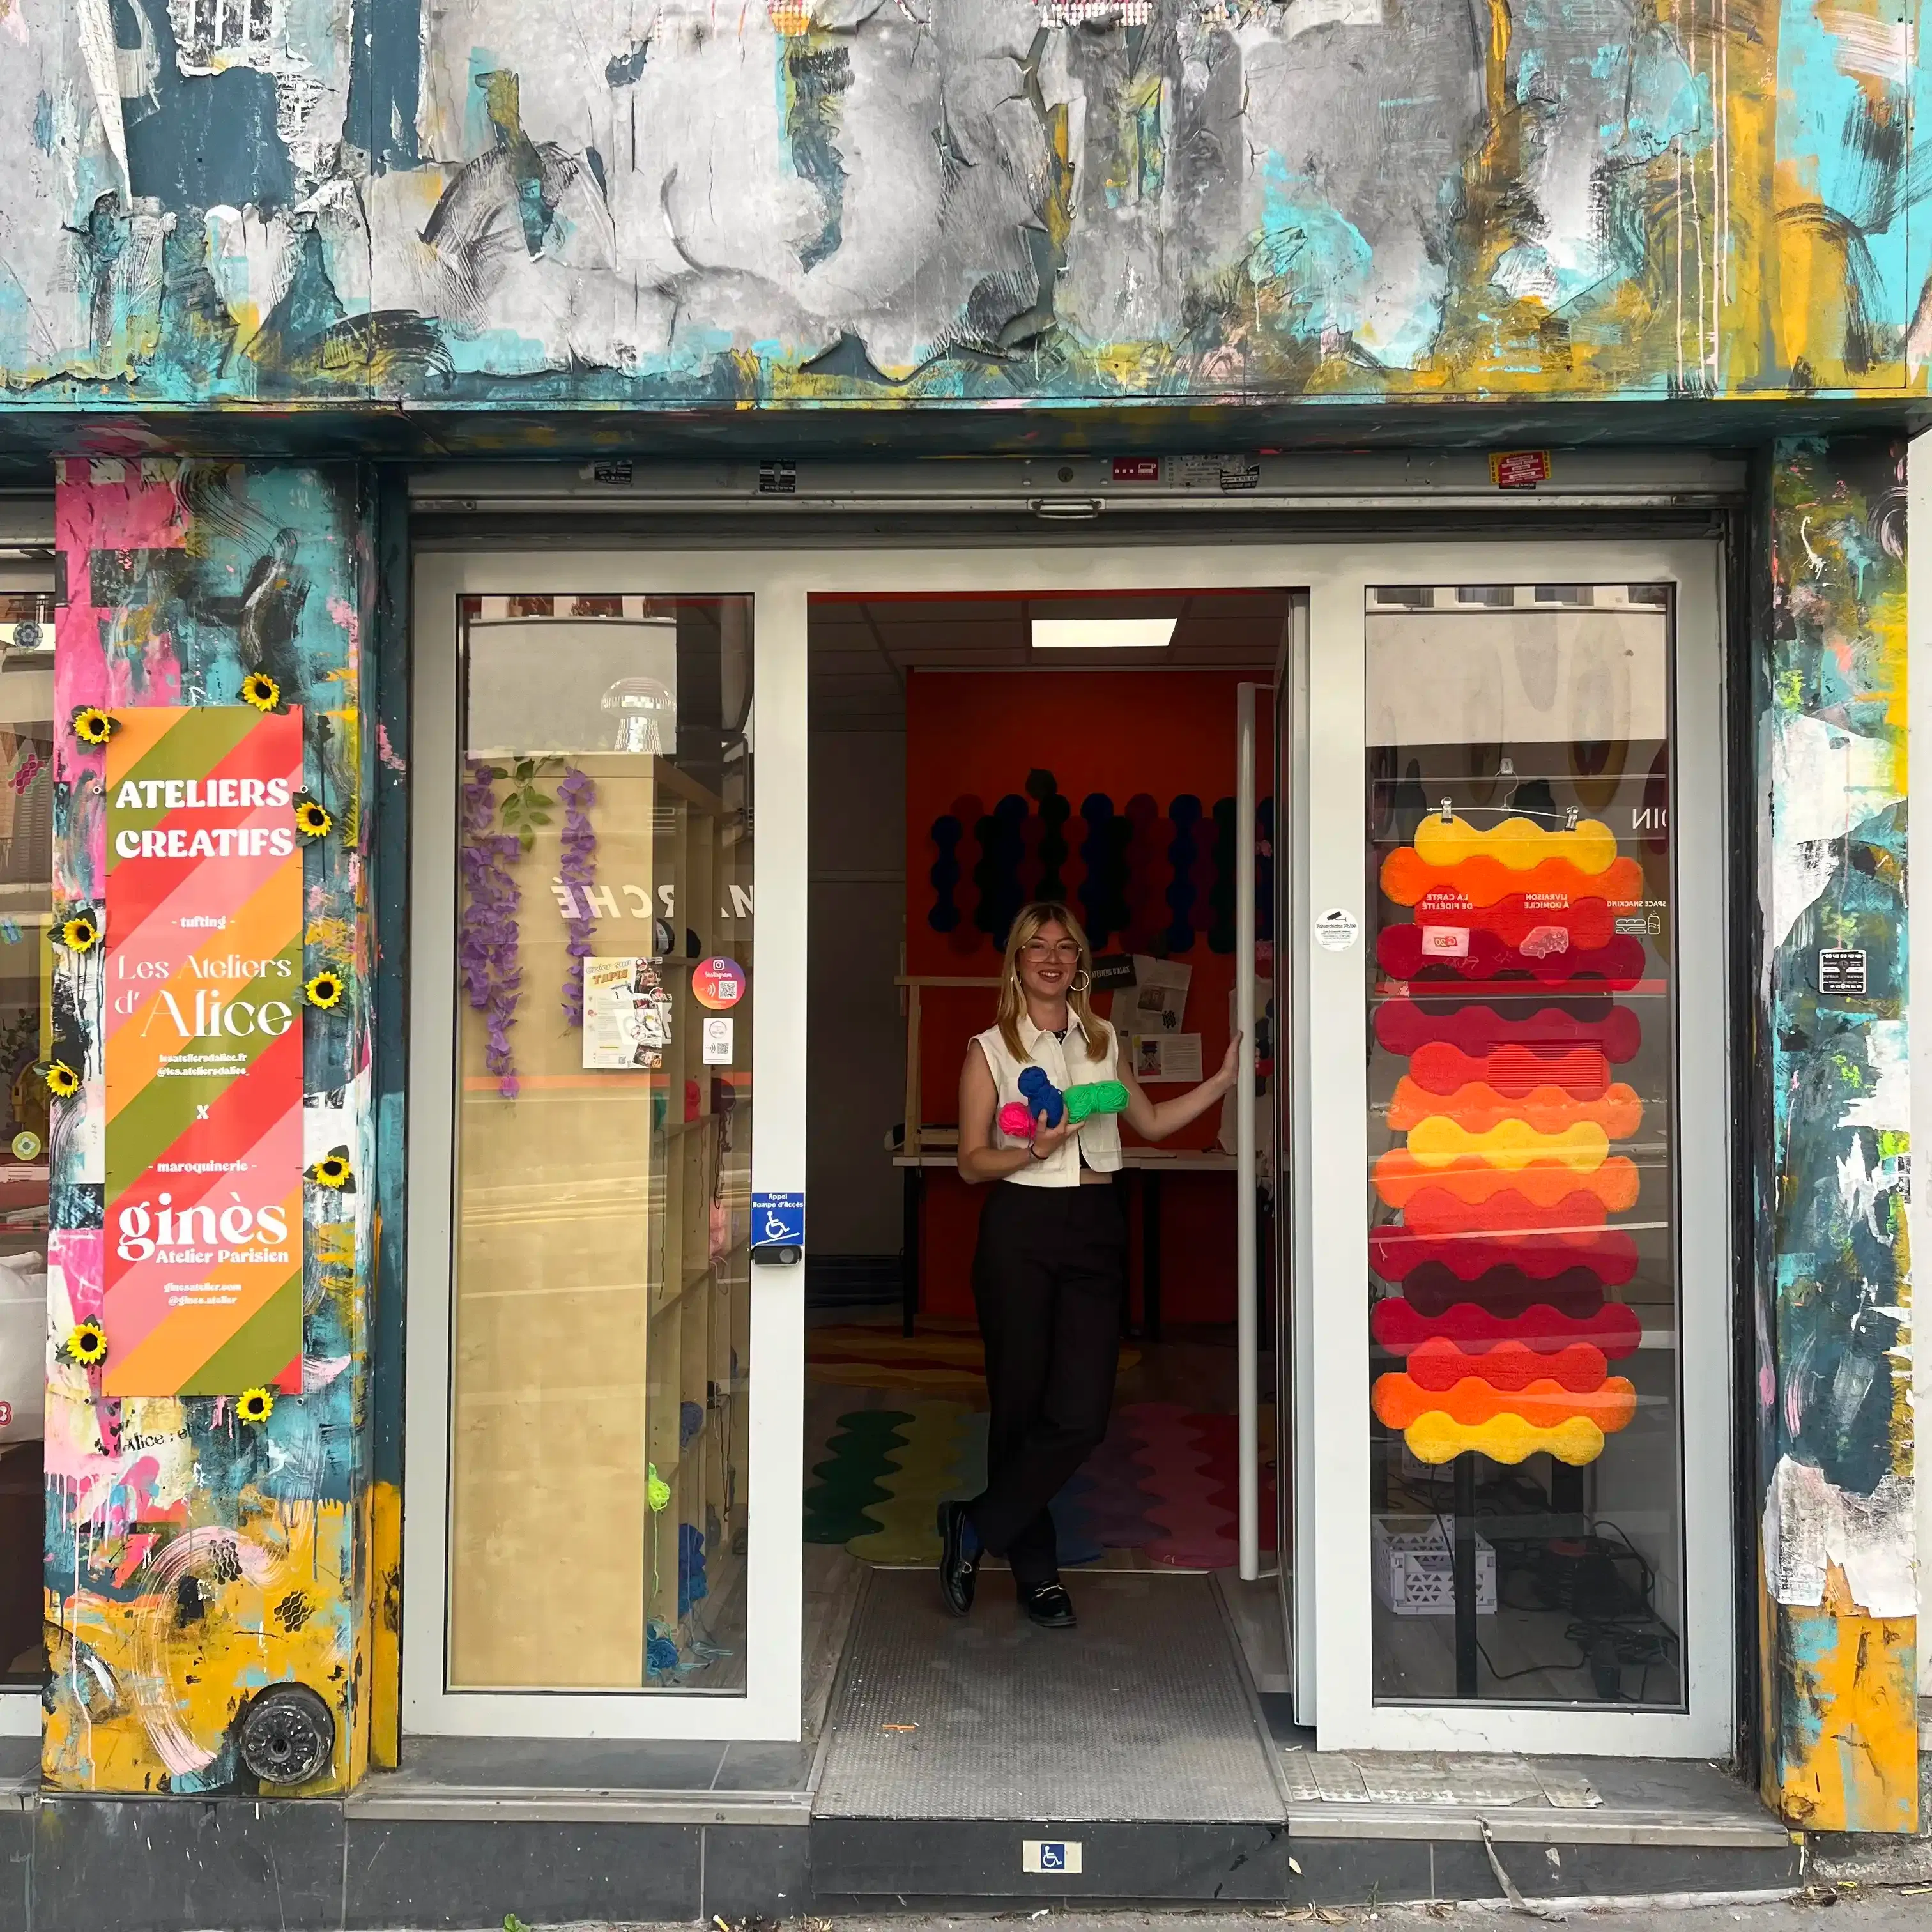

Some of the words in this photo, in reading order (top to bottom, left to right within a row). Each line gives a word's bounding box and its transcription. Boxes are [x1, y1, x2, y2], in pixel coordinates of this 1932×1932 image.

[115, 778, 291, 809] ATELIERS
[115, 827, 294, 859] CREATIFS
[180, 916, 226, 930] tufting
[118, 954, 169, 979] Les
[177, 954, 292, 979] Ateliers
[592, 969, 629, 985] TAPIS
[705, 971, 733, 979] Instagram
[157, 1160, 249, 1174] maroquinerie
[768, 1193, 788, 1201] Appel
[117, 1192, 289, 1261] ginès
[155, 1248, 213, 1264] Atelier
[218, 1248, 289, 1263] Parisien
